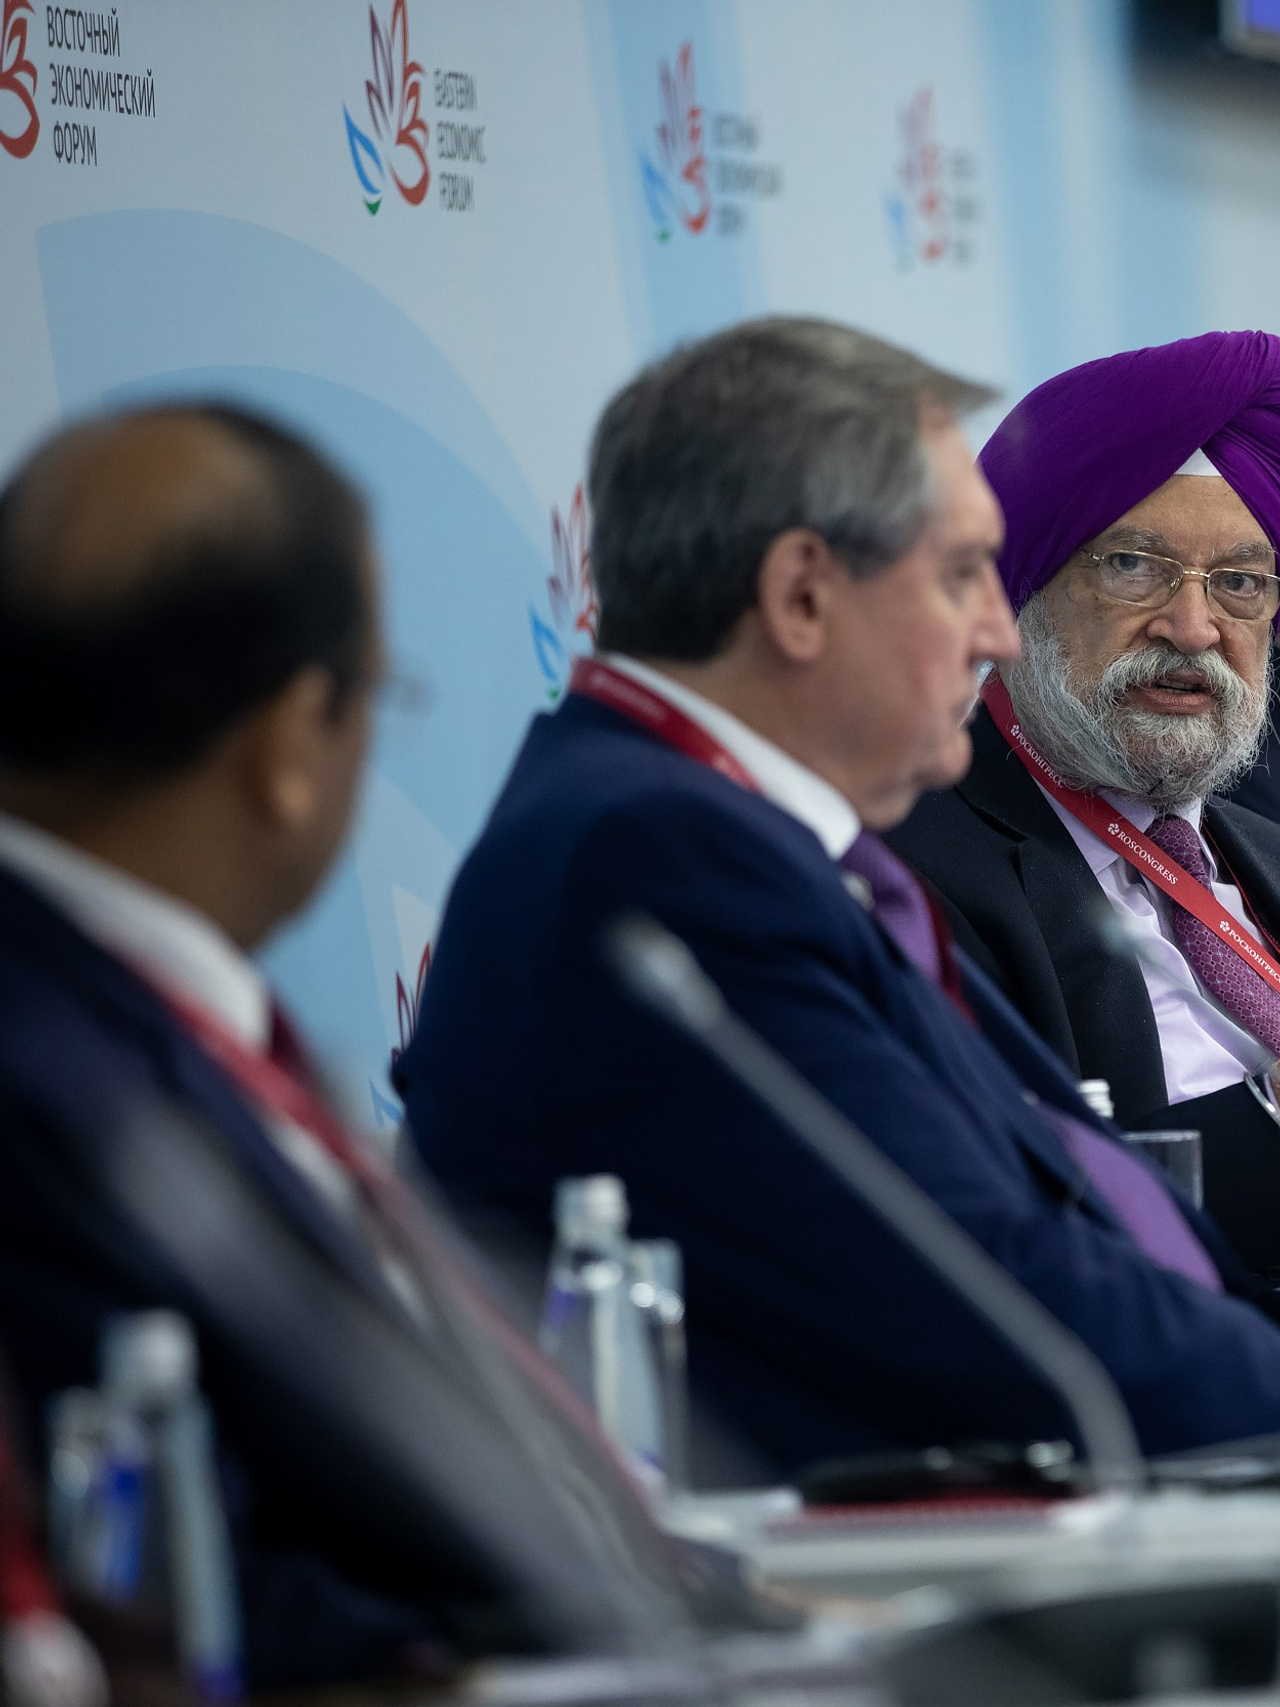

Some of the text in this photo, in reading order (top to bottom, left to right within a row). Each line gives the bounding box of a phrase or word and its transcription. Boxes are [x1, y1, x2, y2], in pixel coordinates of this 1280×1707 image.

[46, 6, 121, 57] ВОСТОЧНЫЙ
[49, 63, 156, 118] ЭКОНОМИЧЕСКИЙ
[53, 120, 98, 167] ФОРУМ
[1016, 732, 1065, 788] РОСКОНГРЕСС
[1117, 831, 1179, 885] ROSCONGRESS
